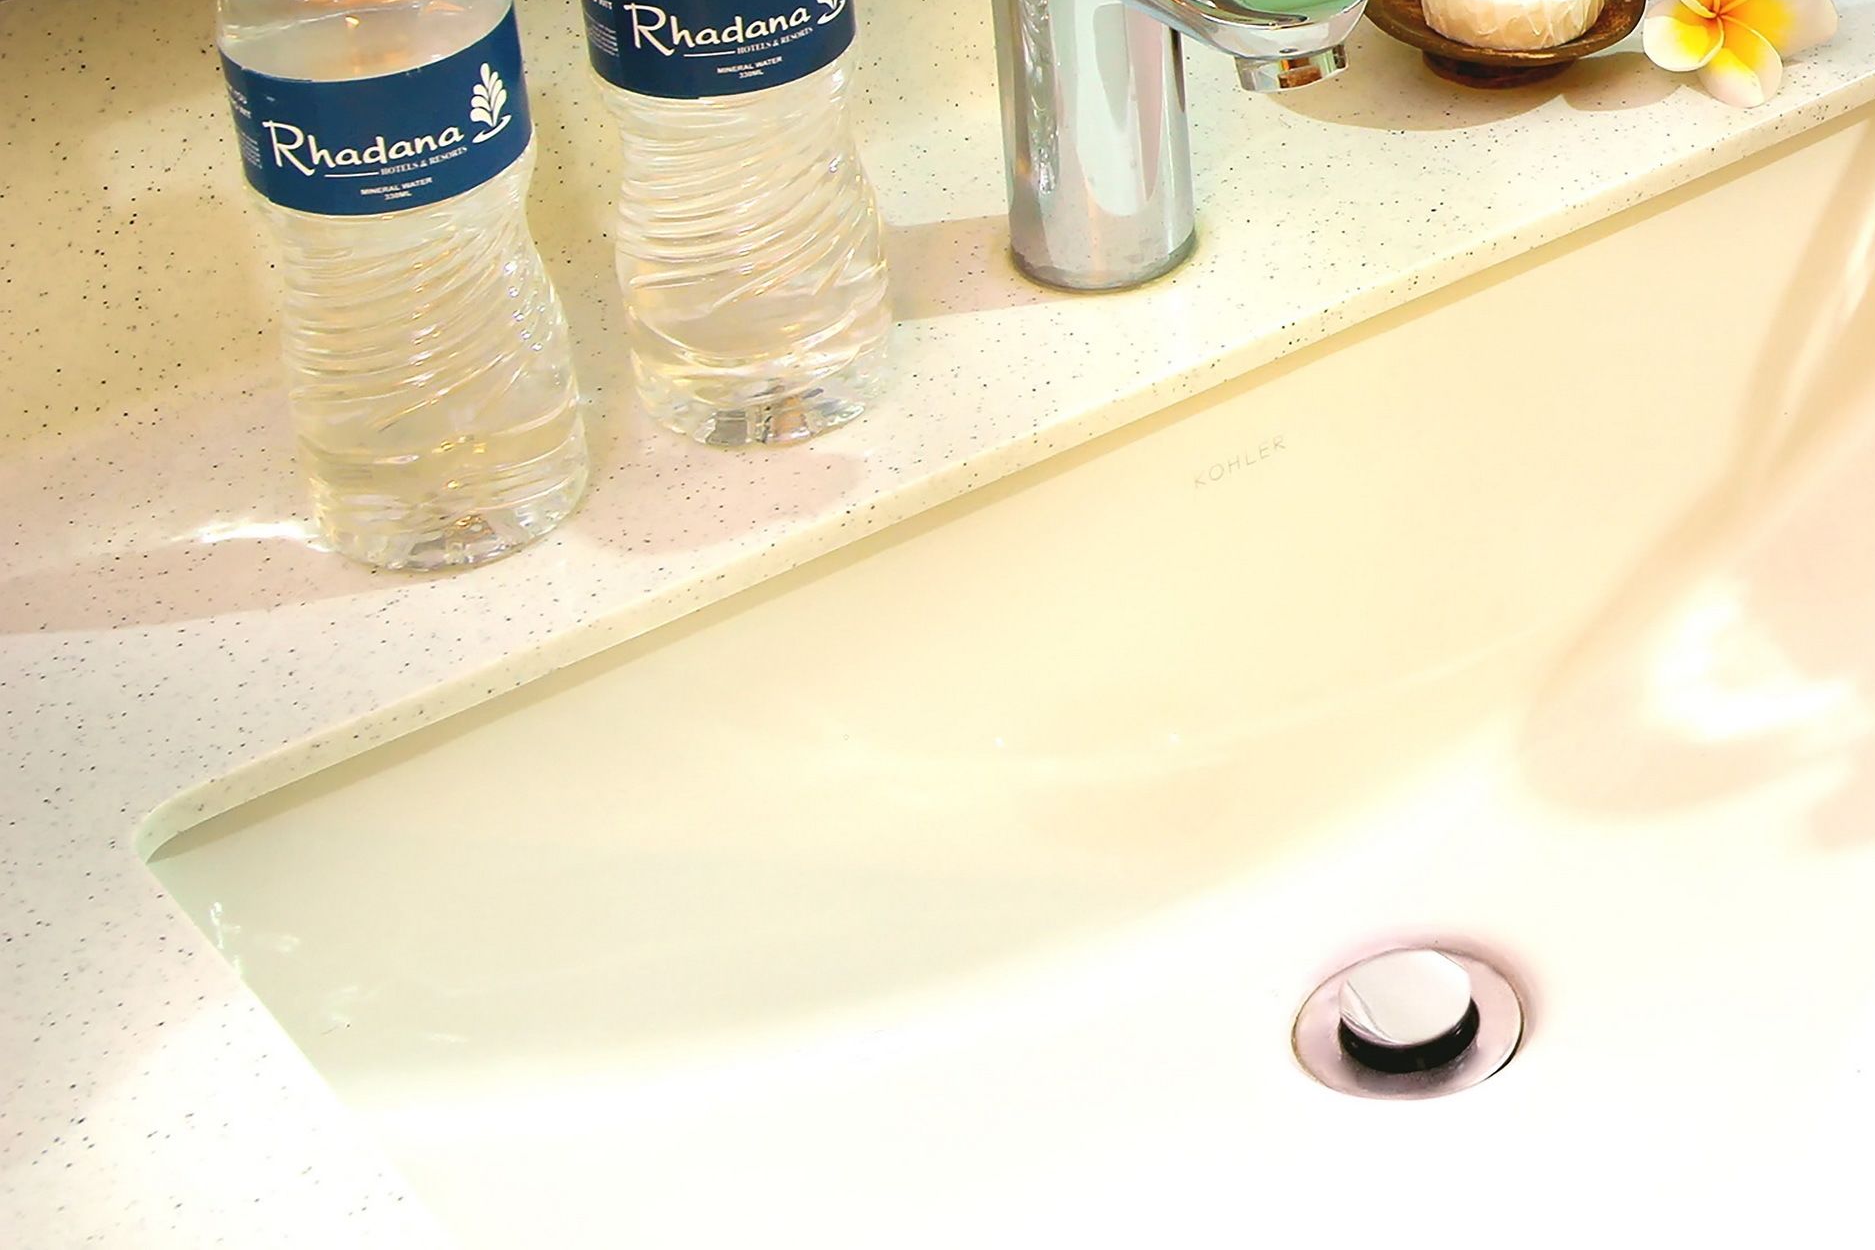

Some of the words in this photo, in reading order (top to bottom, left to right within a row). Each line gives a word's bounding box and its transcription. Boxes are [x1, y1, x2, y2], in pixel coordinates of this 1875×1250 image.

[624, 2, 811, 57] Rhadana
[737, 40, 772, 55] HOTELS
[717, 61, 754, 74] MINERAL
[755, 55, 783, 69] WATER
[262, 119, 465, 176] Rhadana
[380, 161, 418, 176] HOTELS
[359, 183, 401, 196] MINERAL
[401, 176, 433, 190] WATER
[1194, 434, 1286, 489] KOHLER
